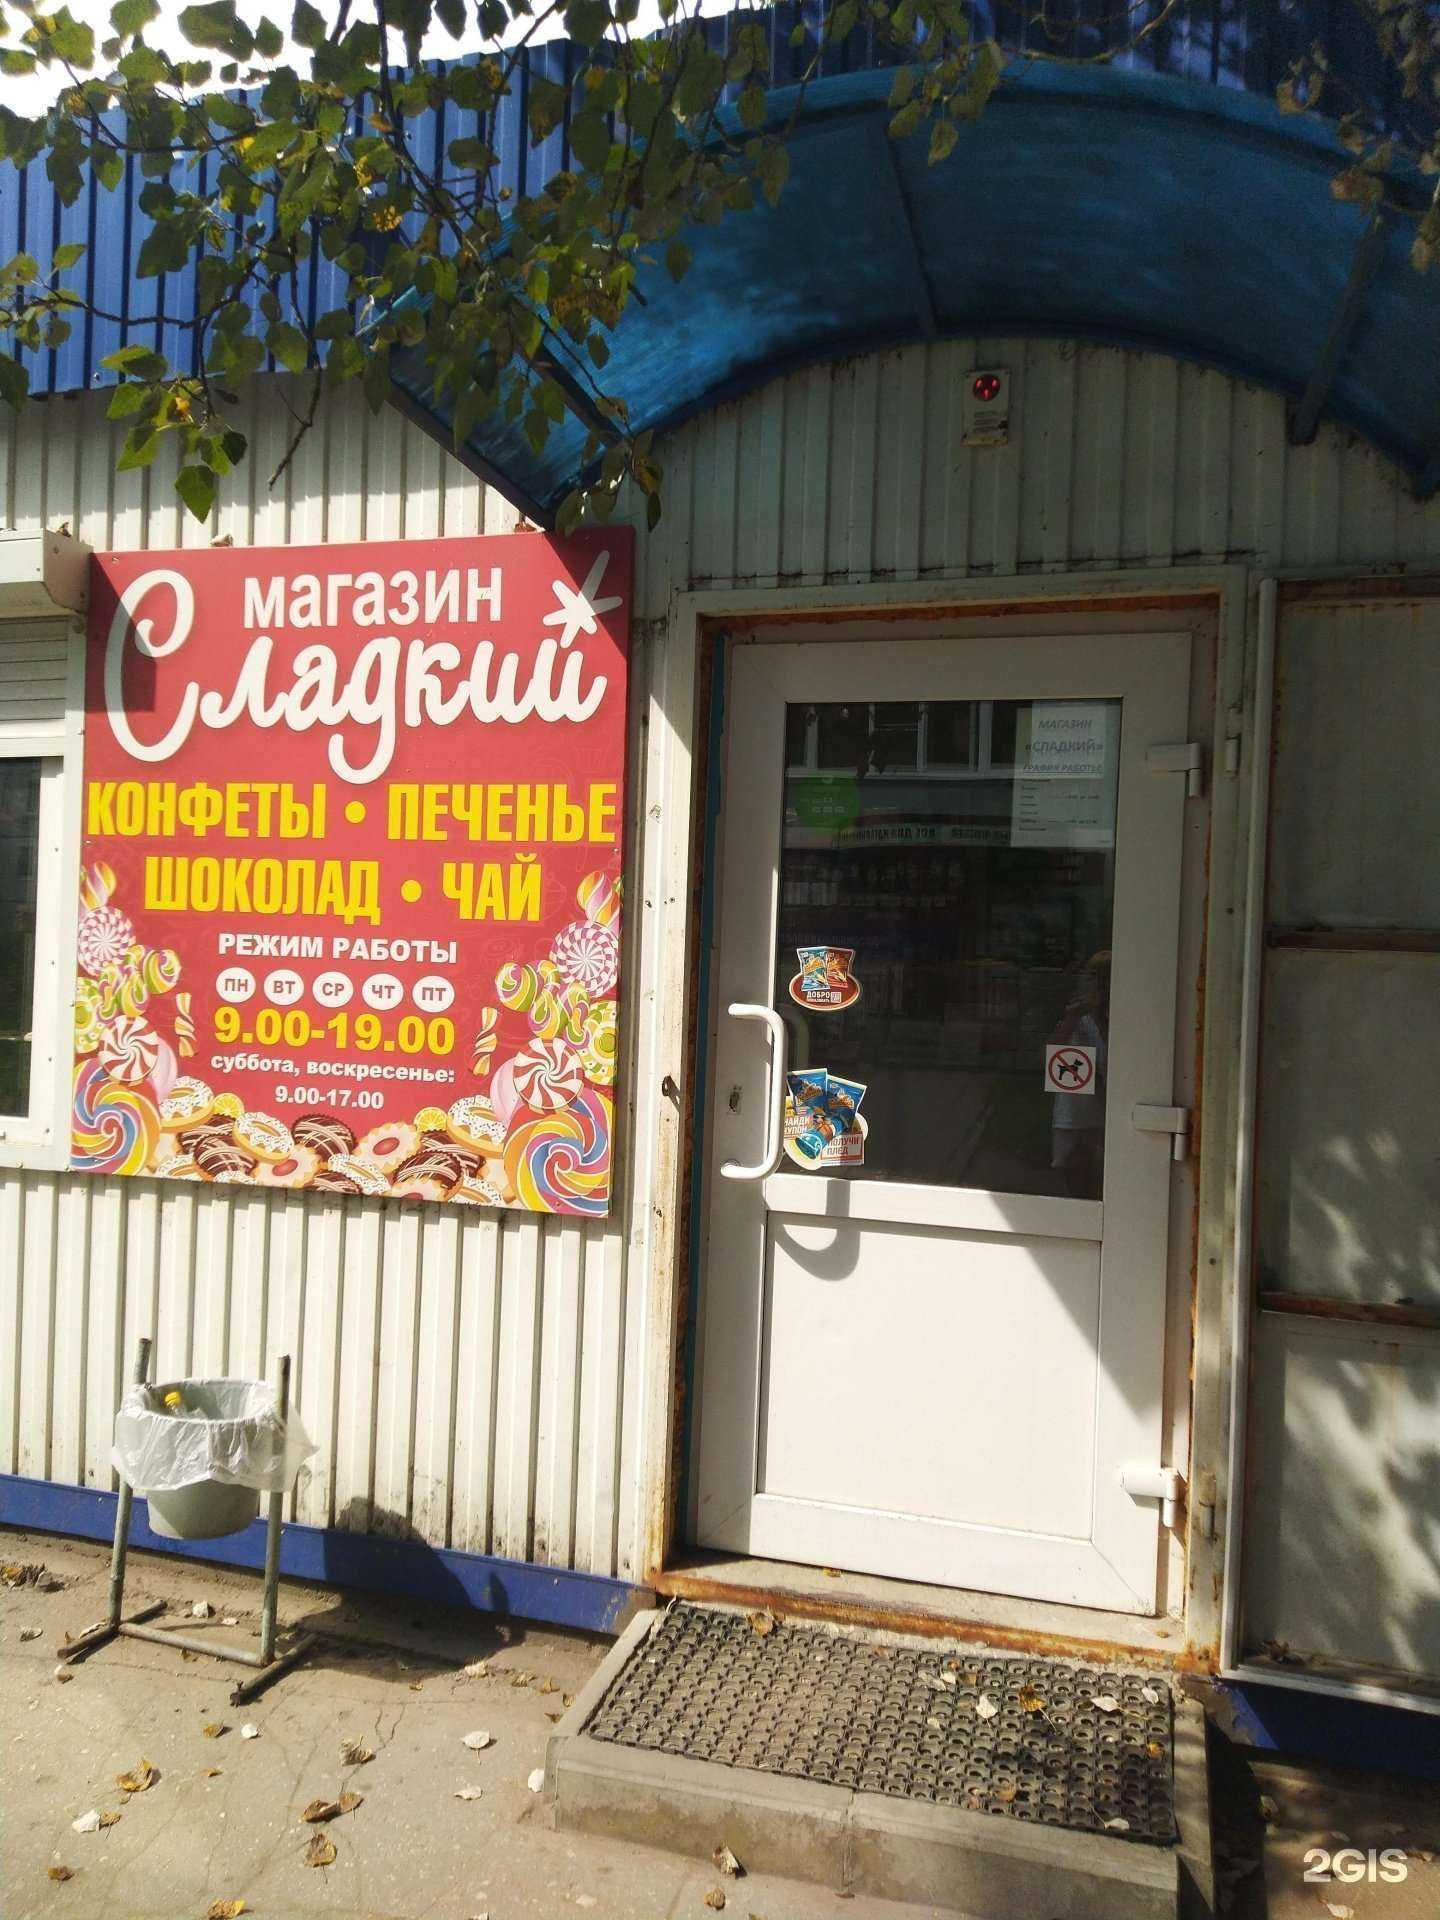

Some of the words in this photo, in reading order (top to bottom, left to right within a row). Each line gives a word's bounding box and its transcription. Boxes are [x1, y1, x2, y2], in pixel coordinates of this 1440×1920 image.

[104, 562, 609, 785] Сладкий
[1038, 719, 1092, 729] МАГАЗИН
[87, 781, 327, 838] КОНФЕТЫ
[387, 783, 617, 842] ПЕЧЕНЬЕ
[144, 856, 380, 925] ШОКОЛАД
[442, 852, 542, 921] ЧАЙ
[218, 933, 323, 958] РЕЖИМ
[332, 937, 457, 963] РАБОТЫ
[224, 979, 249, 992] ПН
[273, 980, 296, 994] ВТ
[322, 982, 345, 996] СР
[371, 984, 396, 998] ЧТ
[421, 987, 447, 1001] ПТ
[806, 991, 831, 999] ДОБРО
[214, 1006, 455, 1055] 9.00-19.00
[210, 1053, 300, 1077] суббота,
[307, 1061, 455, 1083] воскресенье:
[274, 1085, 385, 1109] 9.00-17.00
[827, 1145, 849, 1156] ПЛЕД
